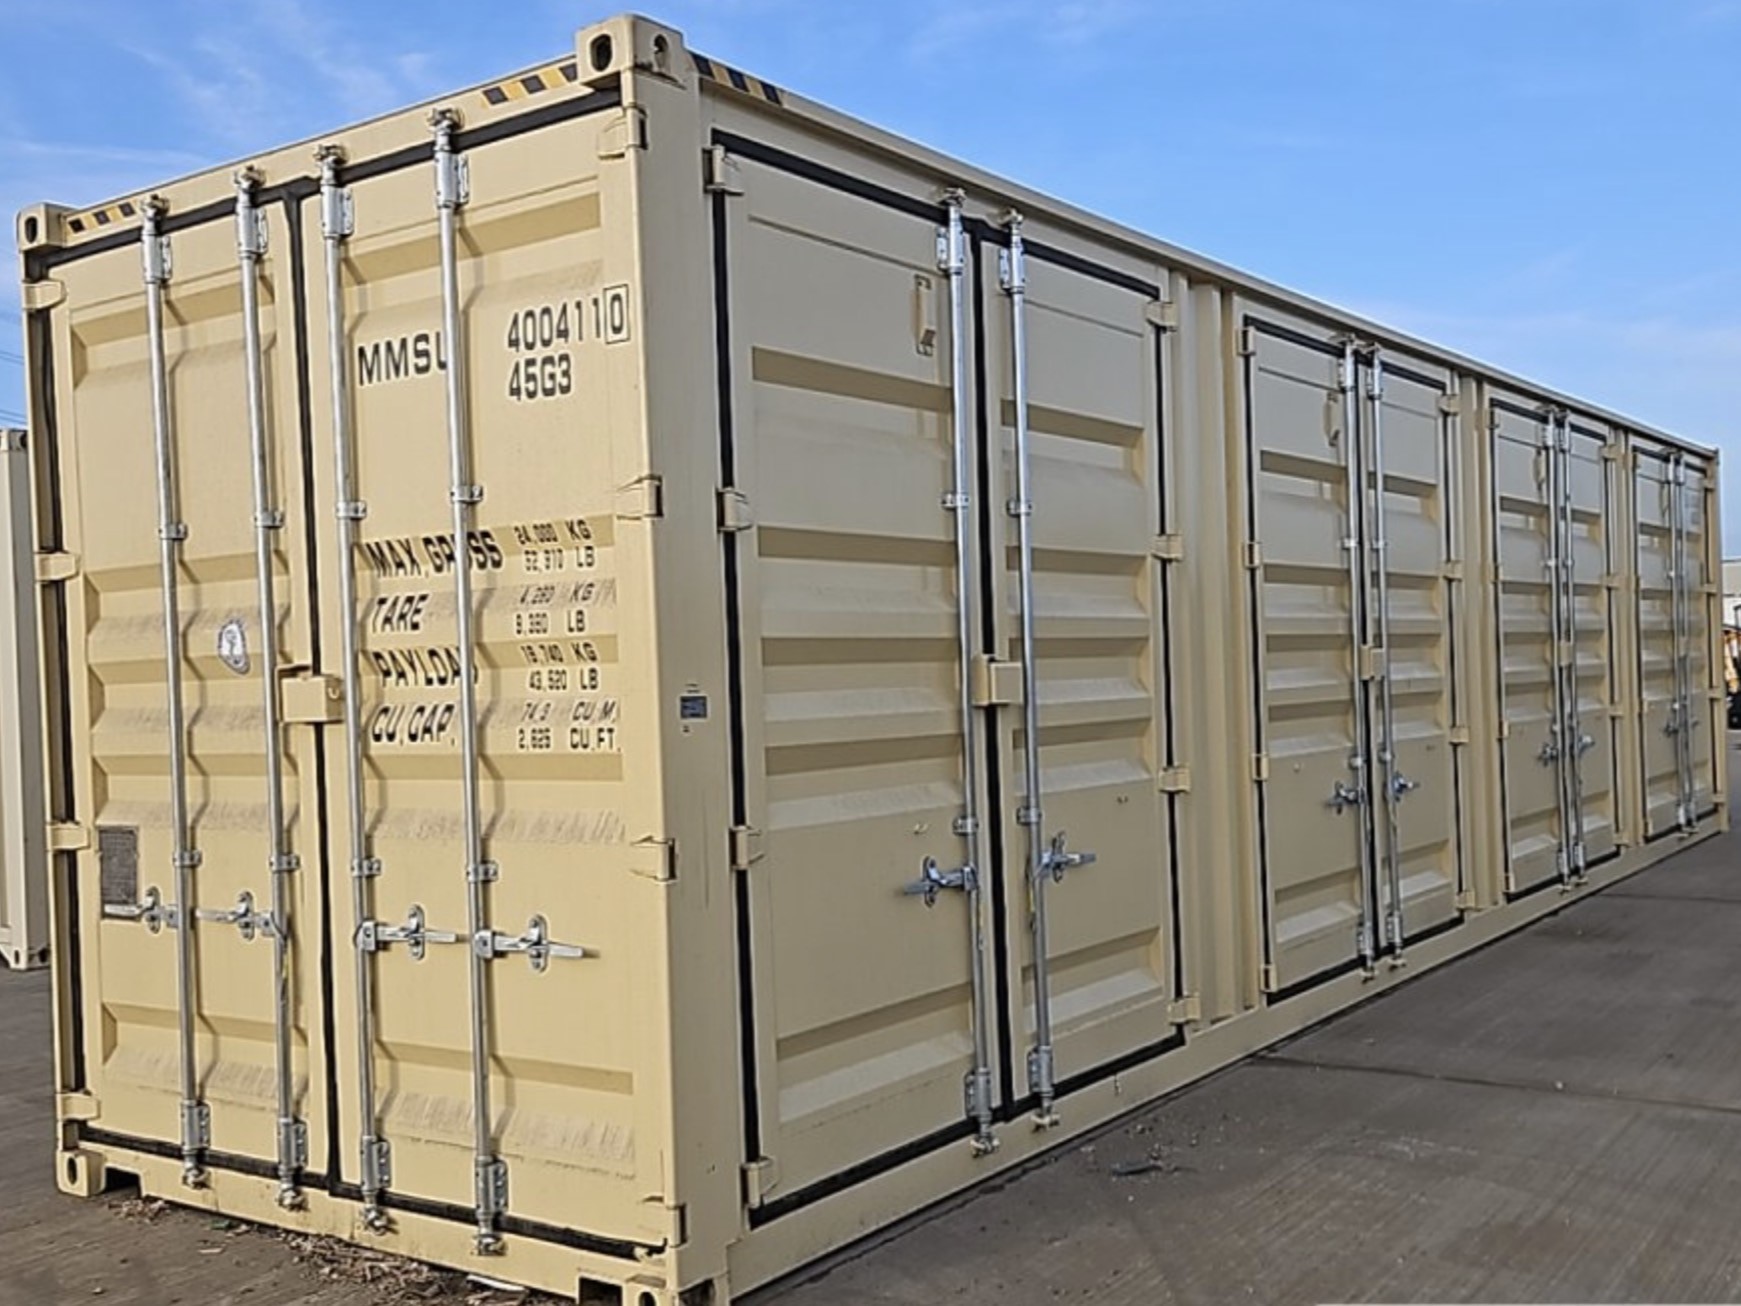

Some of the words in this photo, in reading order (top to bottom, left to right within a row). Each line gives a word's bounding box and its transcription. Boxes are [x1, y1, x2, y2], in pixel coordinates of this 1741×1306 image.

[508, 352, 572, 402] 45G3
[564, 518, 592, 541] KG
[575, 545, 595, 568] LB
[372, 593, 429, 634] TARE
[568, 580, 596, 603] KG
[567, 609, 585, 632] LB
[570, 641, 598, 662] KG
[580, 667, 599, 690] LB
